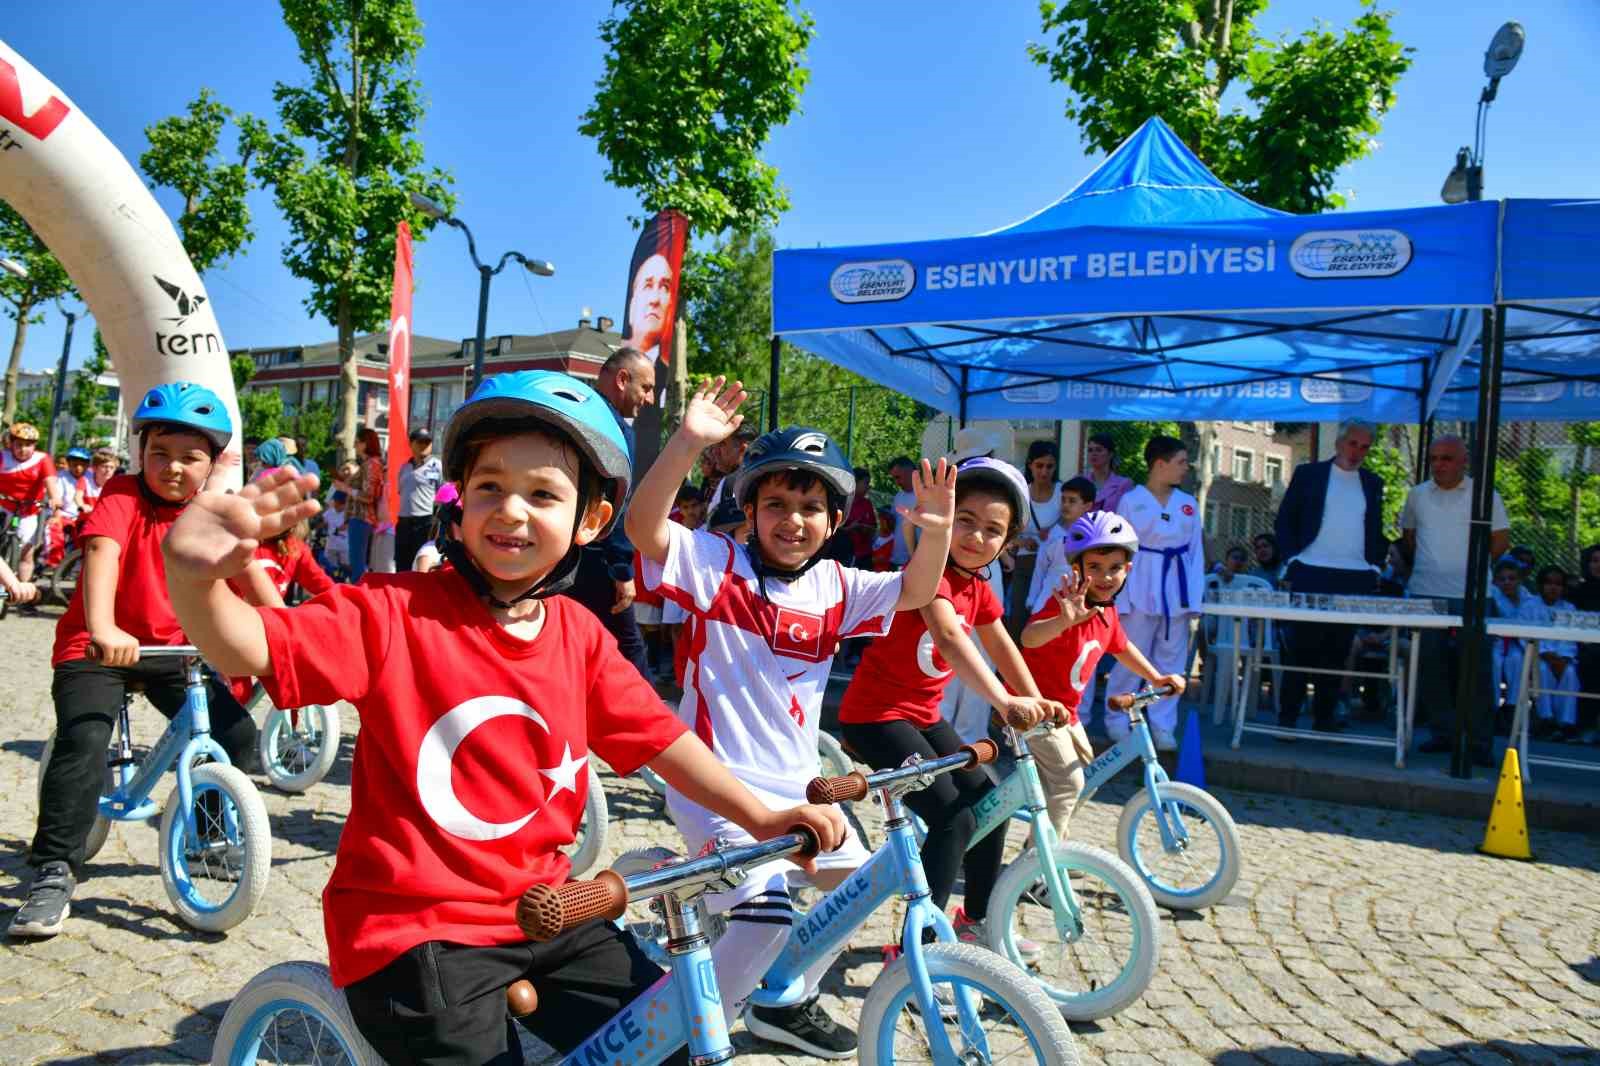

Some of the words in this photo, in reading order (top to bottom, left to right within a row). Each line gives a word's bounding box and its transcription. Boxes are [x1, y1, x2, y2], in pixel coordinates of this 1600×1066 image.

[925, 254, 1078, 291] ESENYURT
[1087, 239, 1276, 279] BELEDİYESİ
[155, 331, 221, 356] tern
[797, 876, 870, 945] BALANCE
